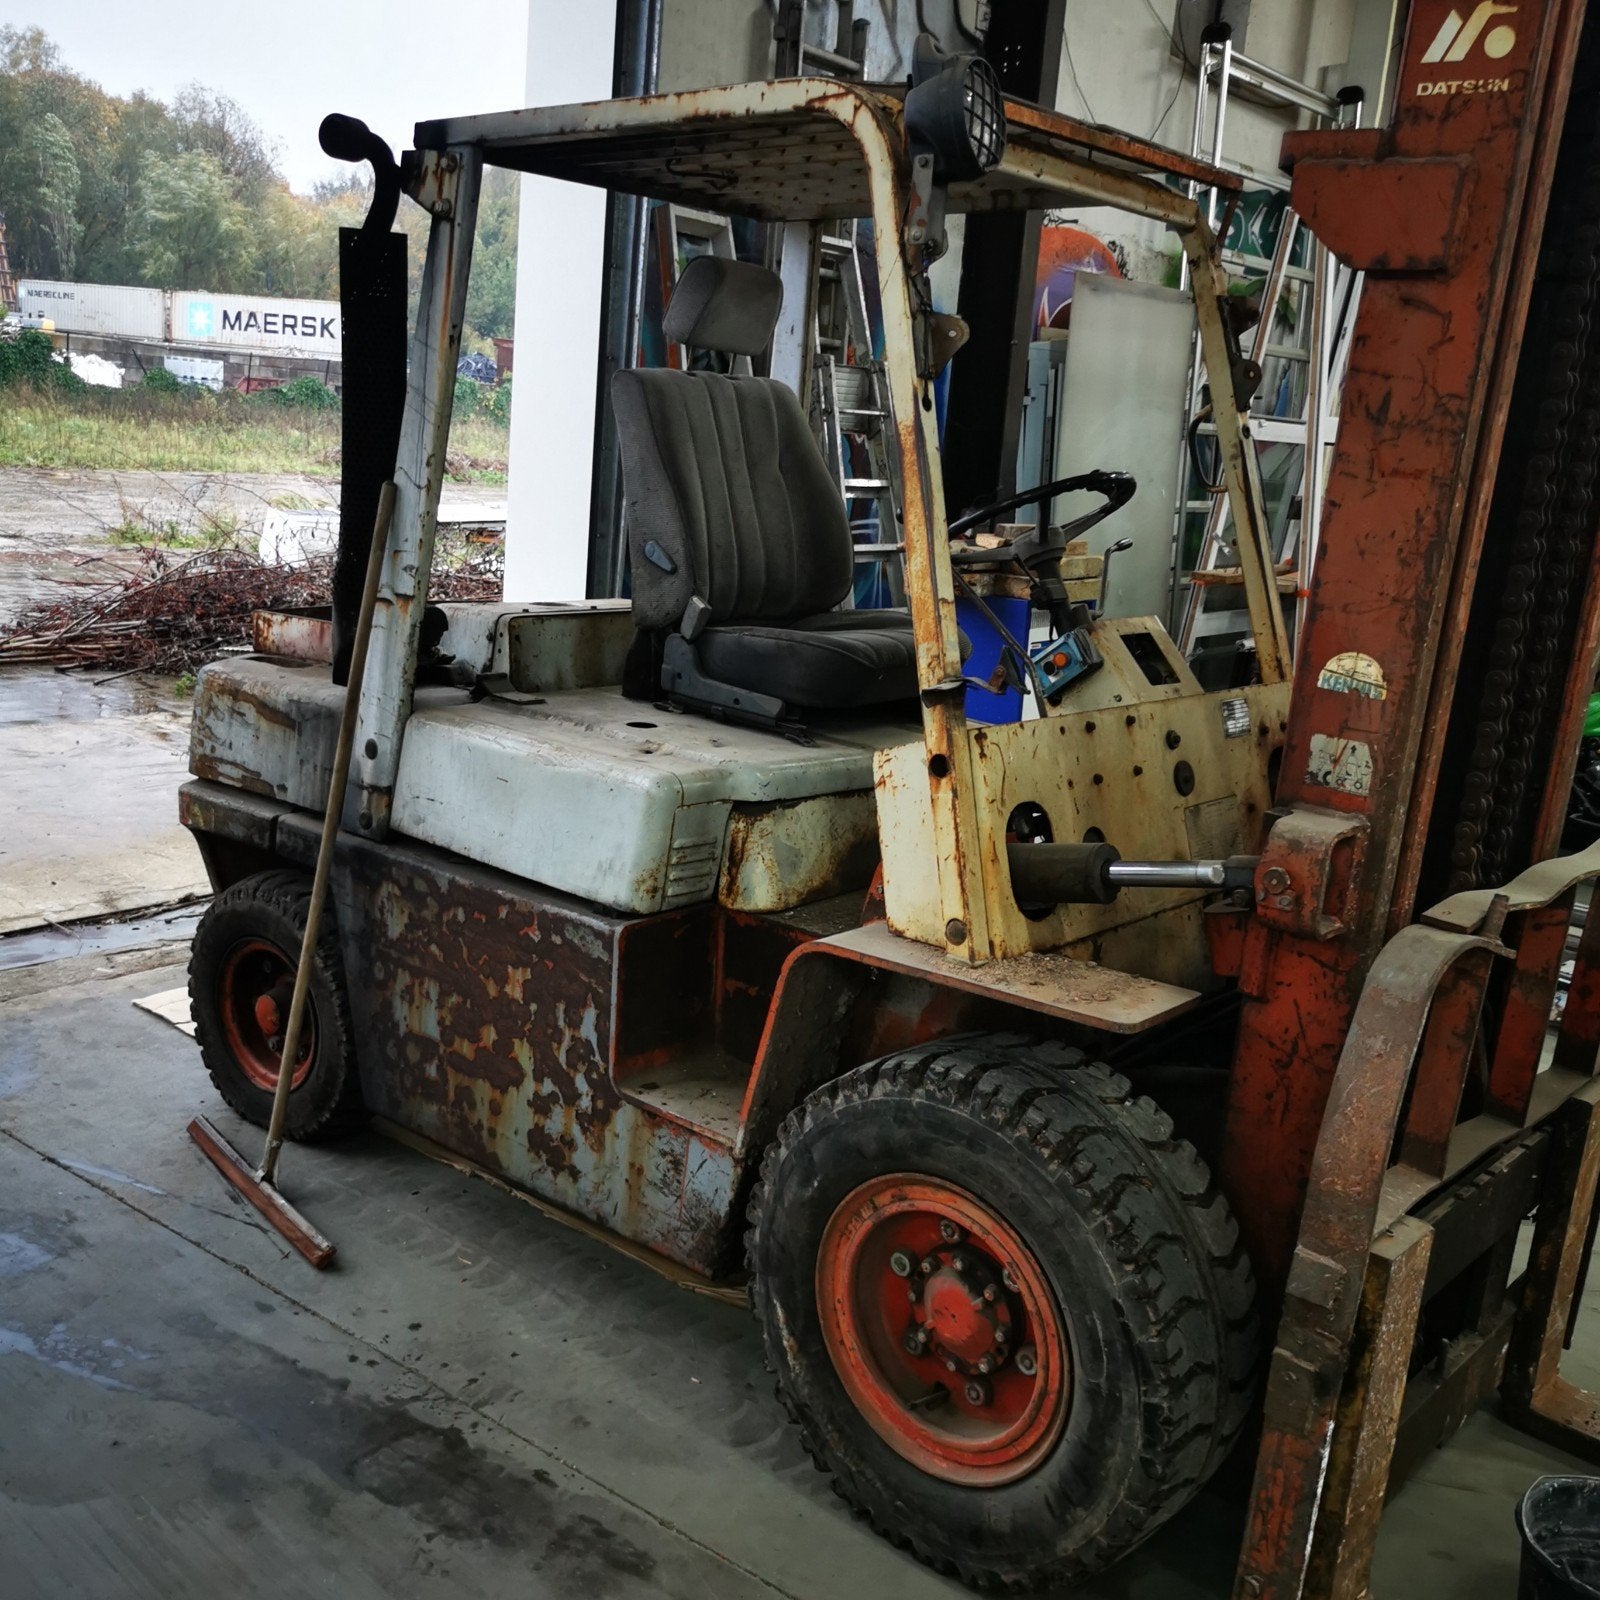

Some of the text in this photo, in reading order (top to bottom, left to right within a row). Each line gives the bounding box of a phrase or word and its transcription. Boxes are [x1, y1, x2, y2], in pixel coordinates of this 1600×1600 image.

[1417, 78, 1510, 96] DATSUN
[58, 291, 75, 301] LINE
[222, 309, 337, 339] MAERSK
